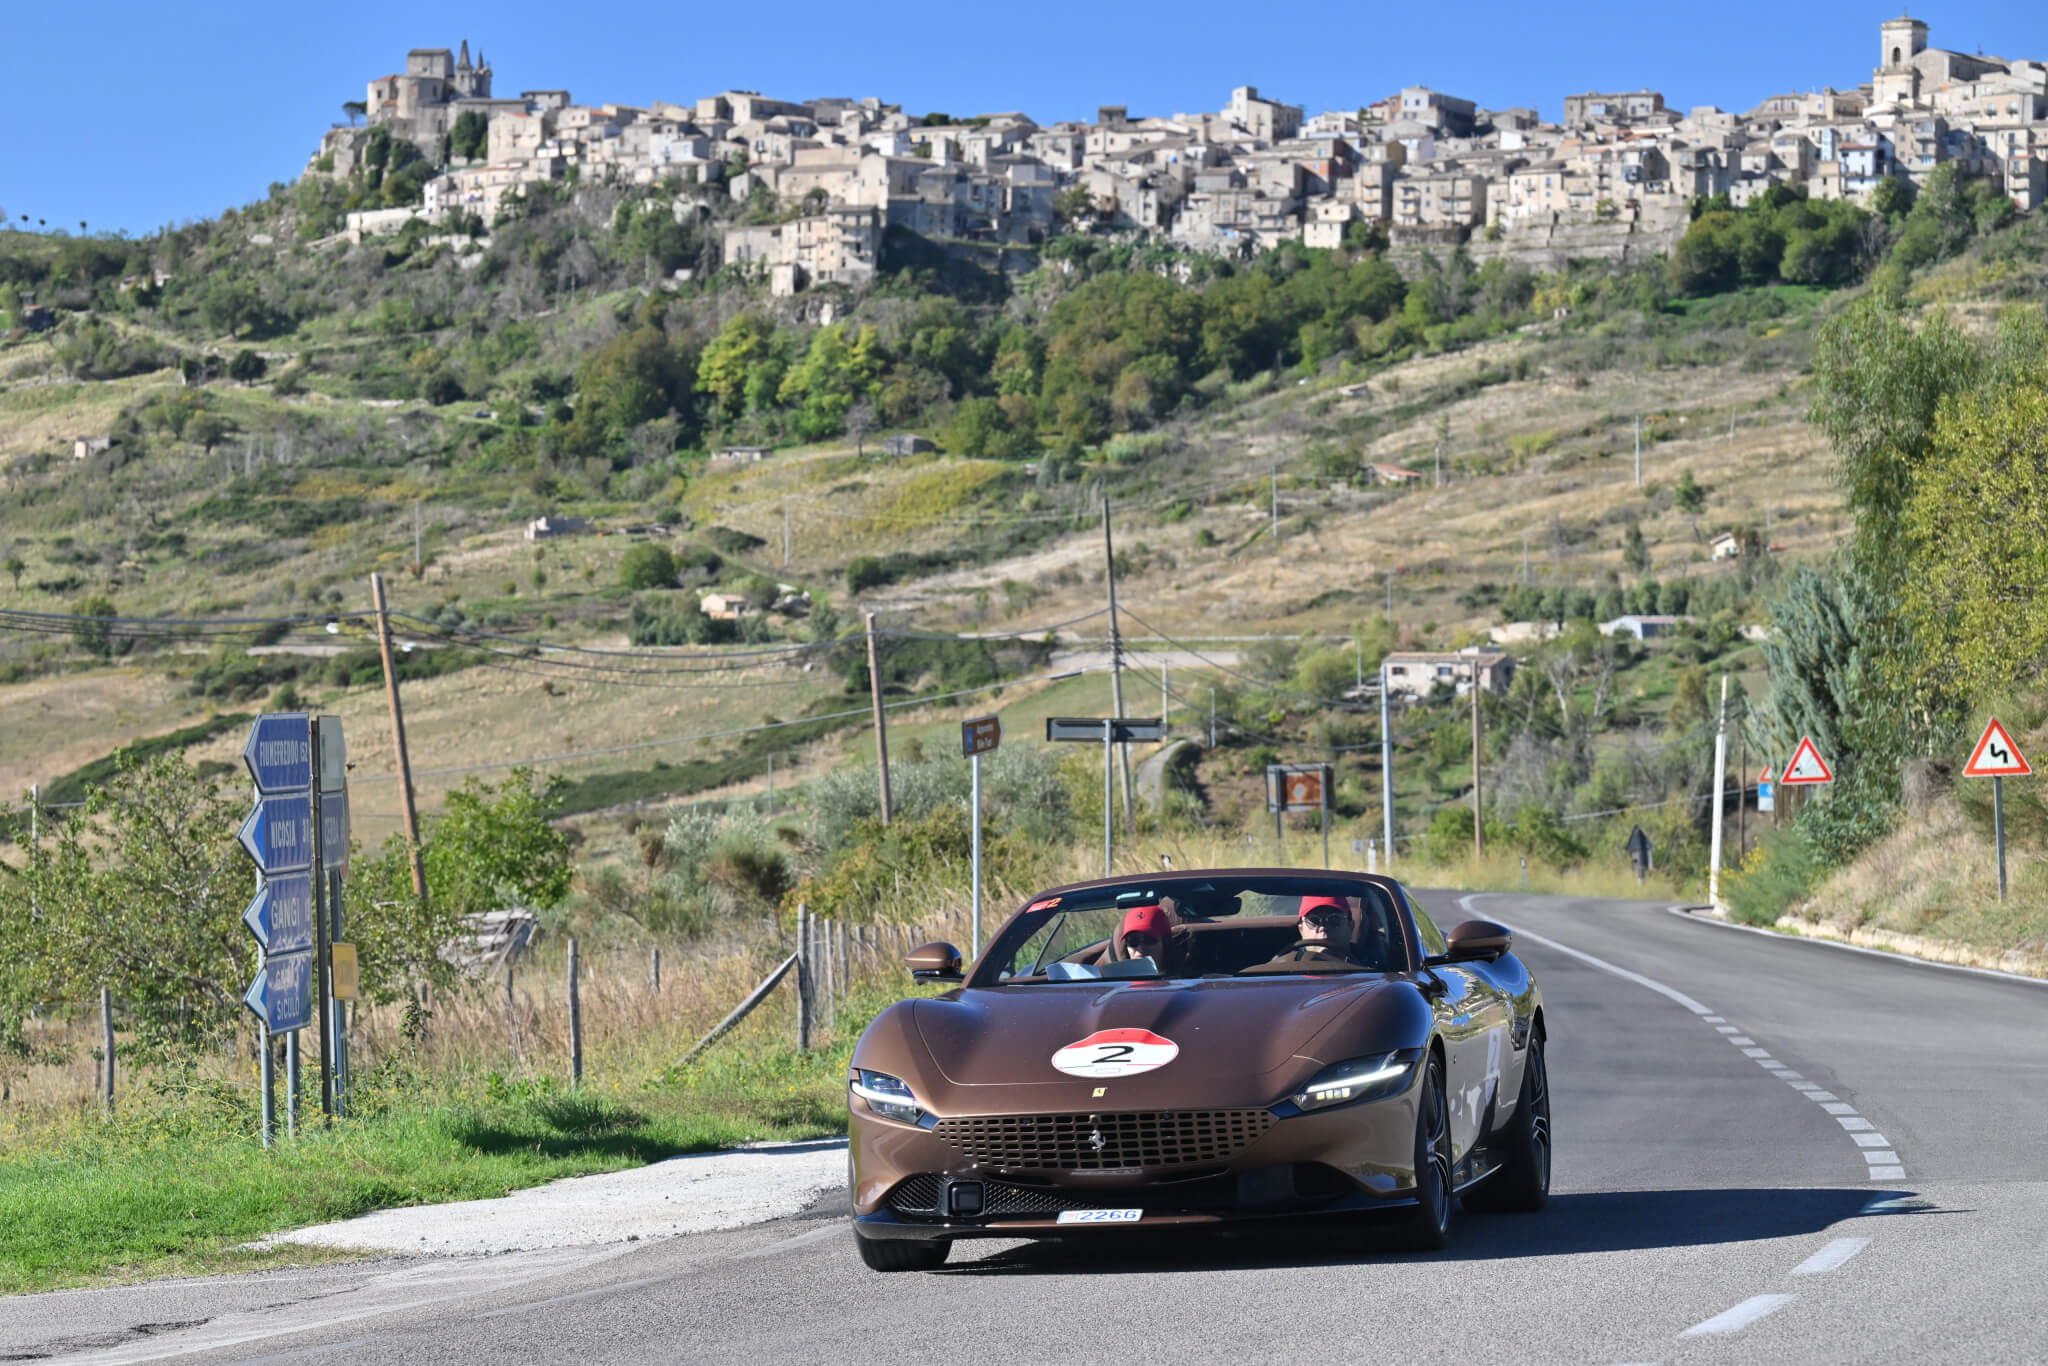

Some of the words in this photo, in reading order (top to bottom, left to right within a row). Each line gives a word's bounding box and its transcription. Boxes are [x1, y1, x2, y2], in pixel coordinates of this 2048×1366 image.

[259, 740, 298, 767] FIUMEFREDDO
[270, 819, 296, 849] NICOSIA
[271, 898, 300, 931] GANGI
[1048, 897, 1063, 909] 2
[276, 995, 300, 1021] SICULO
[1090, 1045, 1134, 1064] 2
